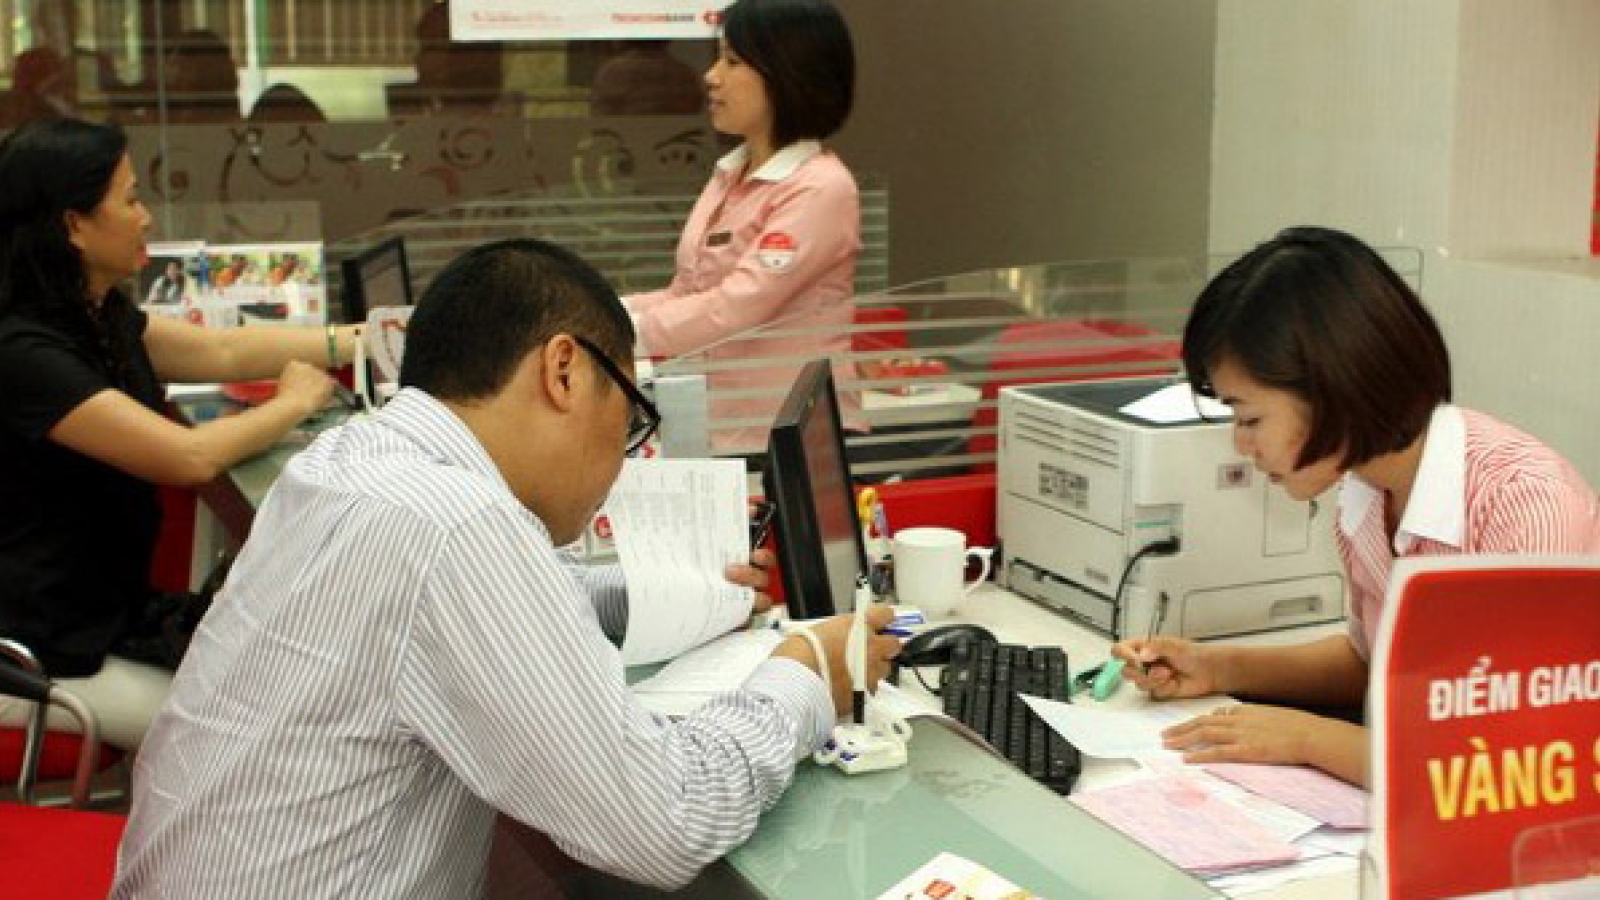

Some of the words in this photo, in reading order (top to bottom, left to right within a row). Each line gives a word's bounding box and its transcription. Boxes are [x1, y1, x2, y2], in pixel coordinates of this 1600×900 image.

[1428, 655, 1521, 721] ĐIỂM
[1529, 660, 1600, 708] GIAO
[1427, 736, 1576, 820] VÀNG
